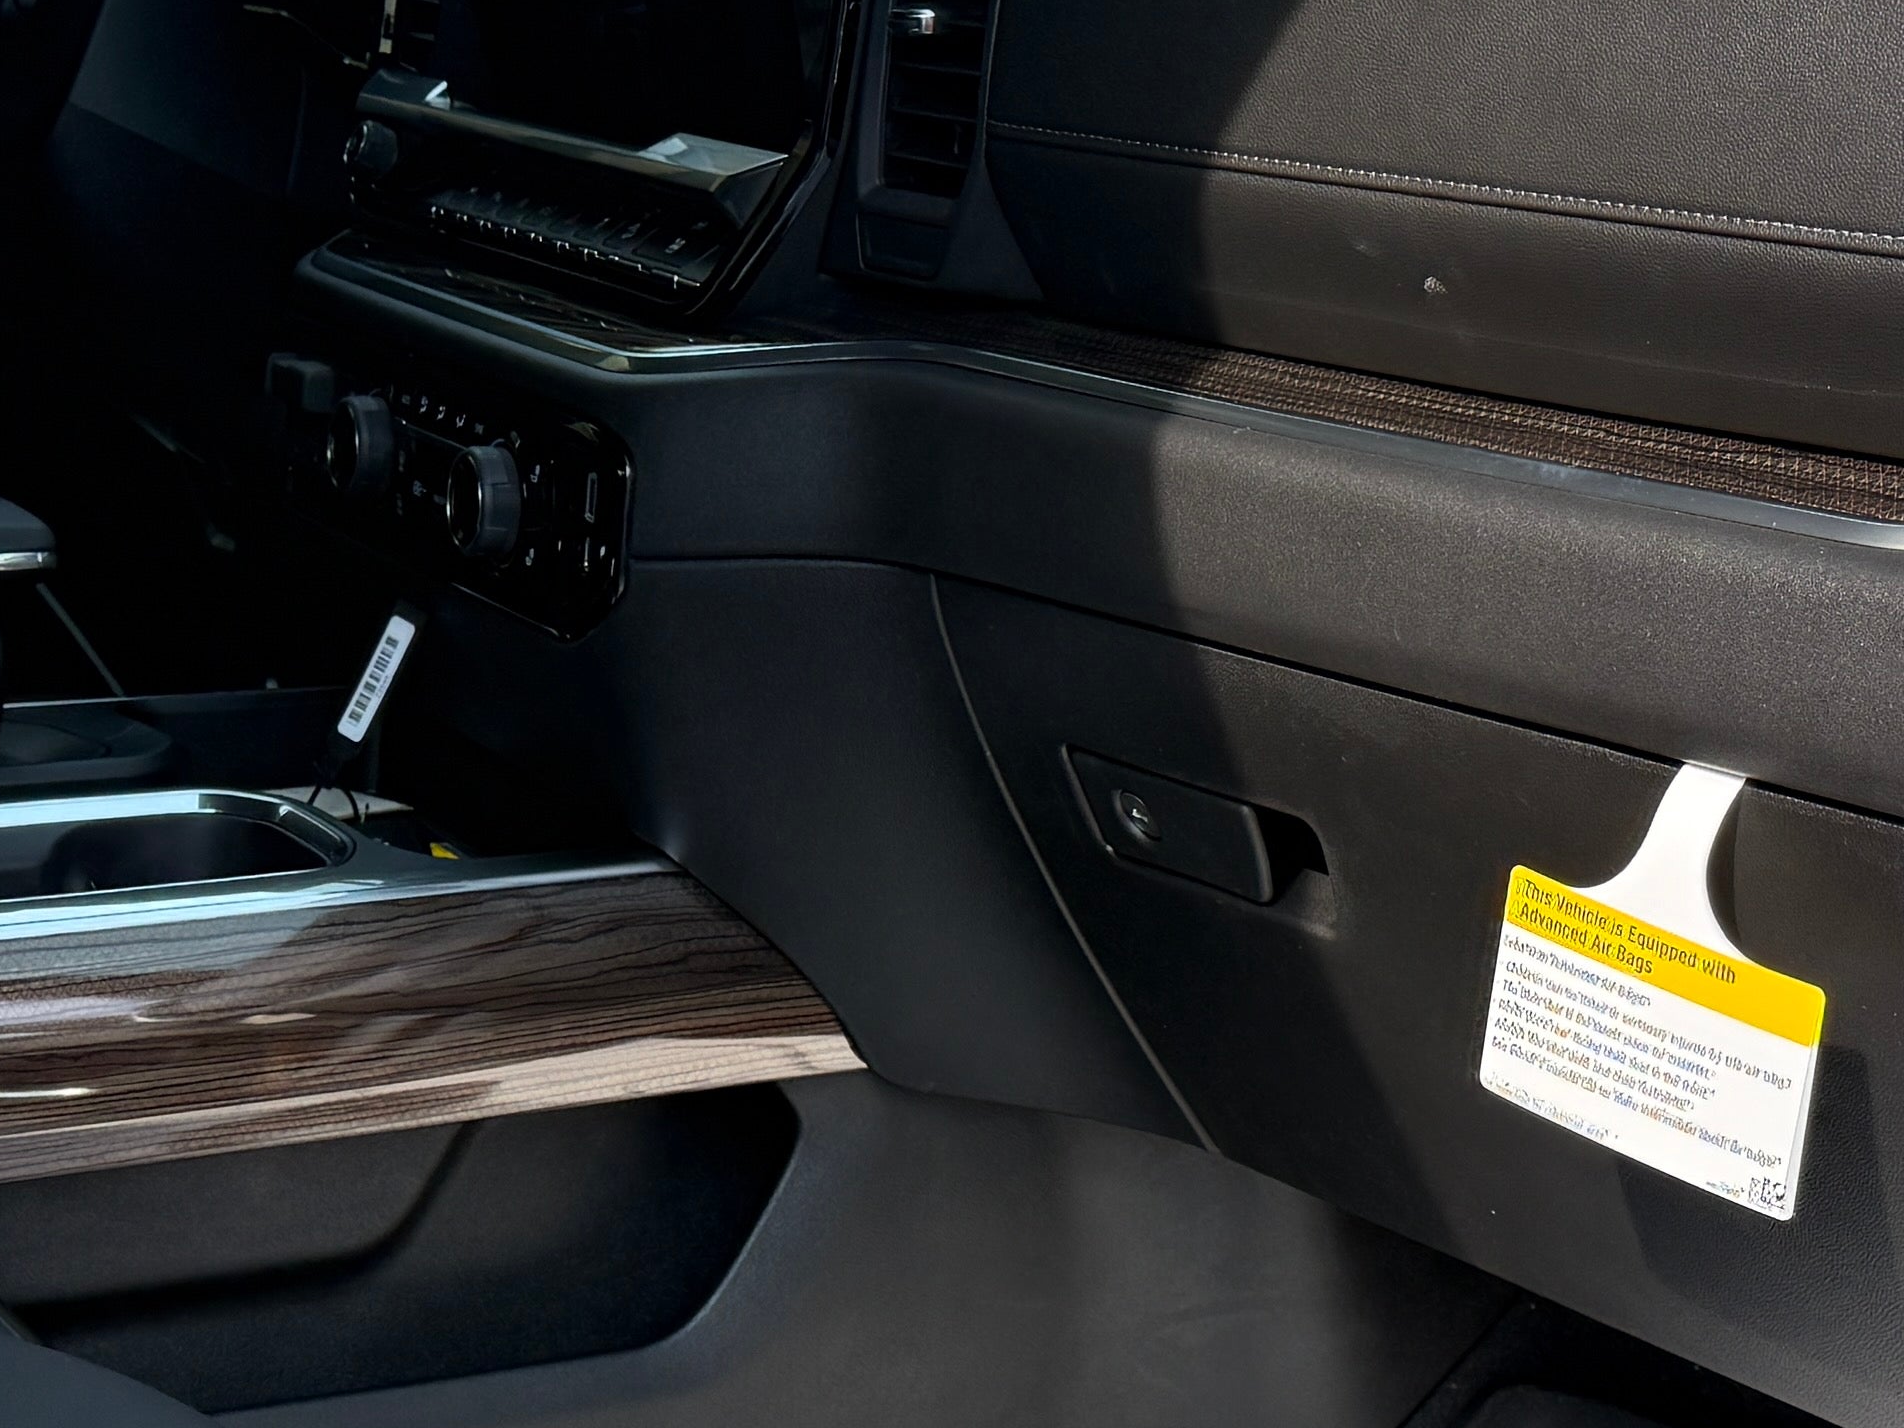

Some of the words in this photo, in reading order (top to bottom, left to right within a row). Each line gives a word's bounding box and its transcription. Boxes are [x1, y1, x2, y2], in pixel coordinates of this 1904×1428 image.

[1520, 902, 1588, 948] Advanced
[1592, 934, 1613, 956] Air
[1615, 944, 1654, 975] Bags
[1628, 924, 1698, 969] Equipped
[1702, 958, 1737, 985] with
